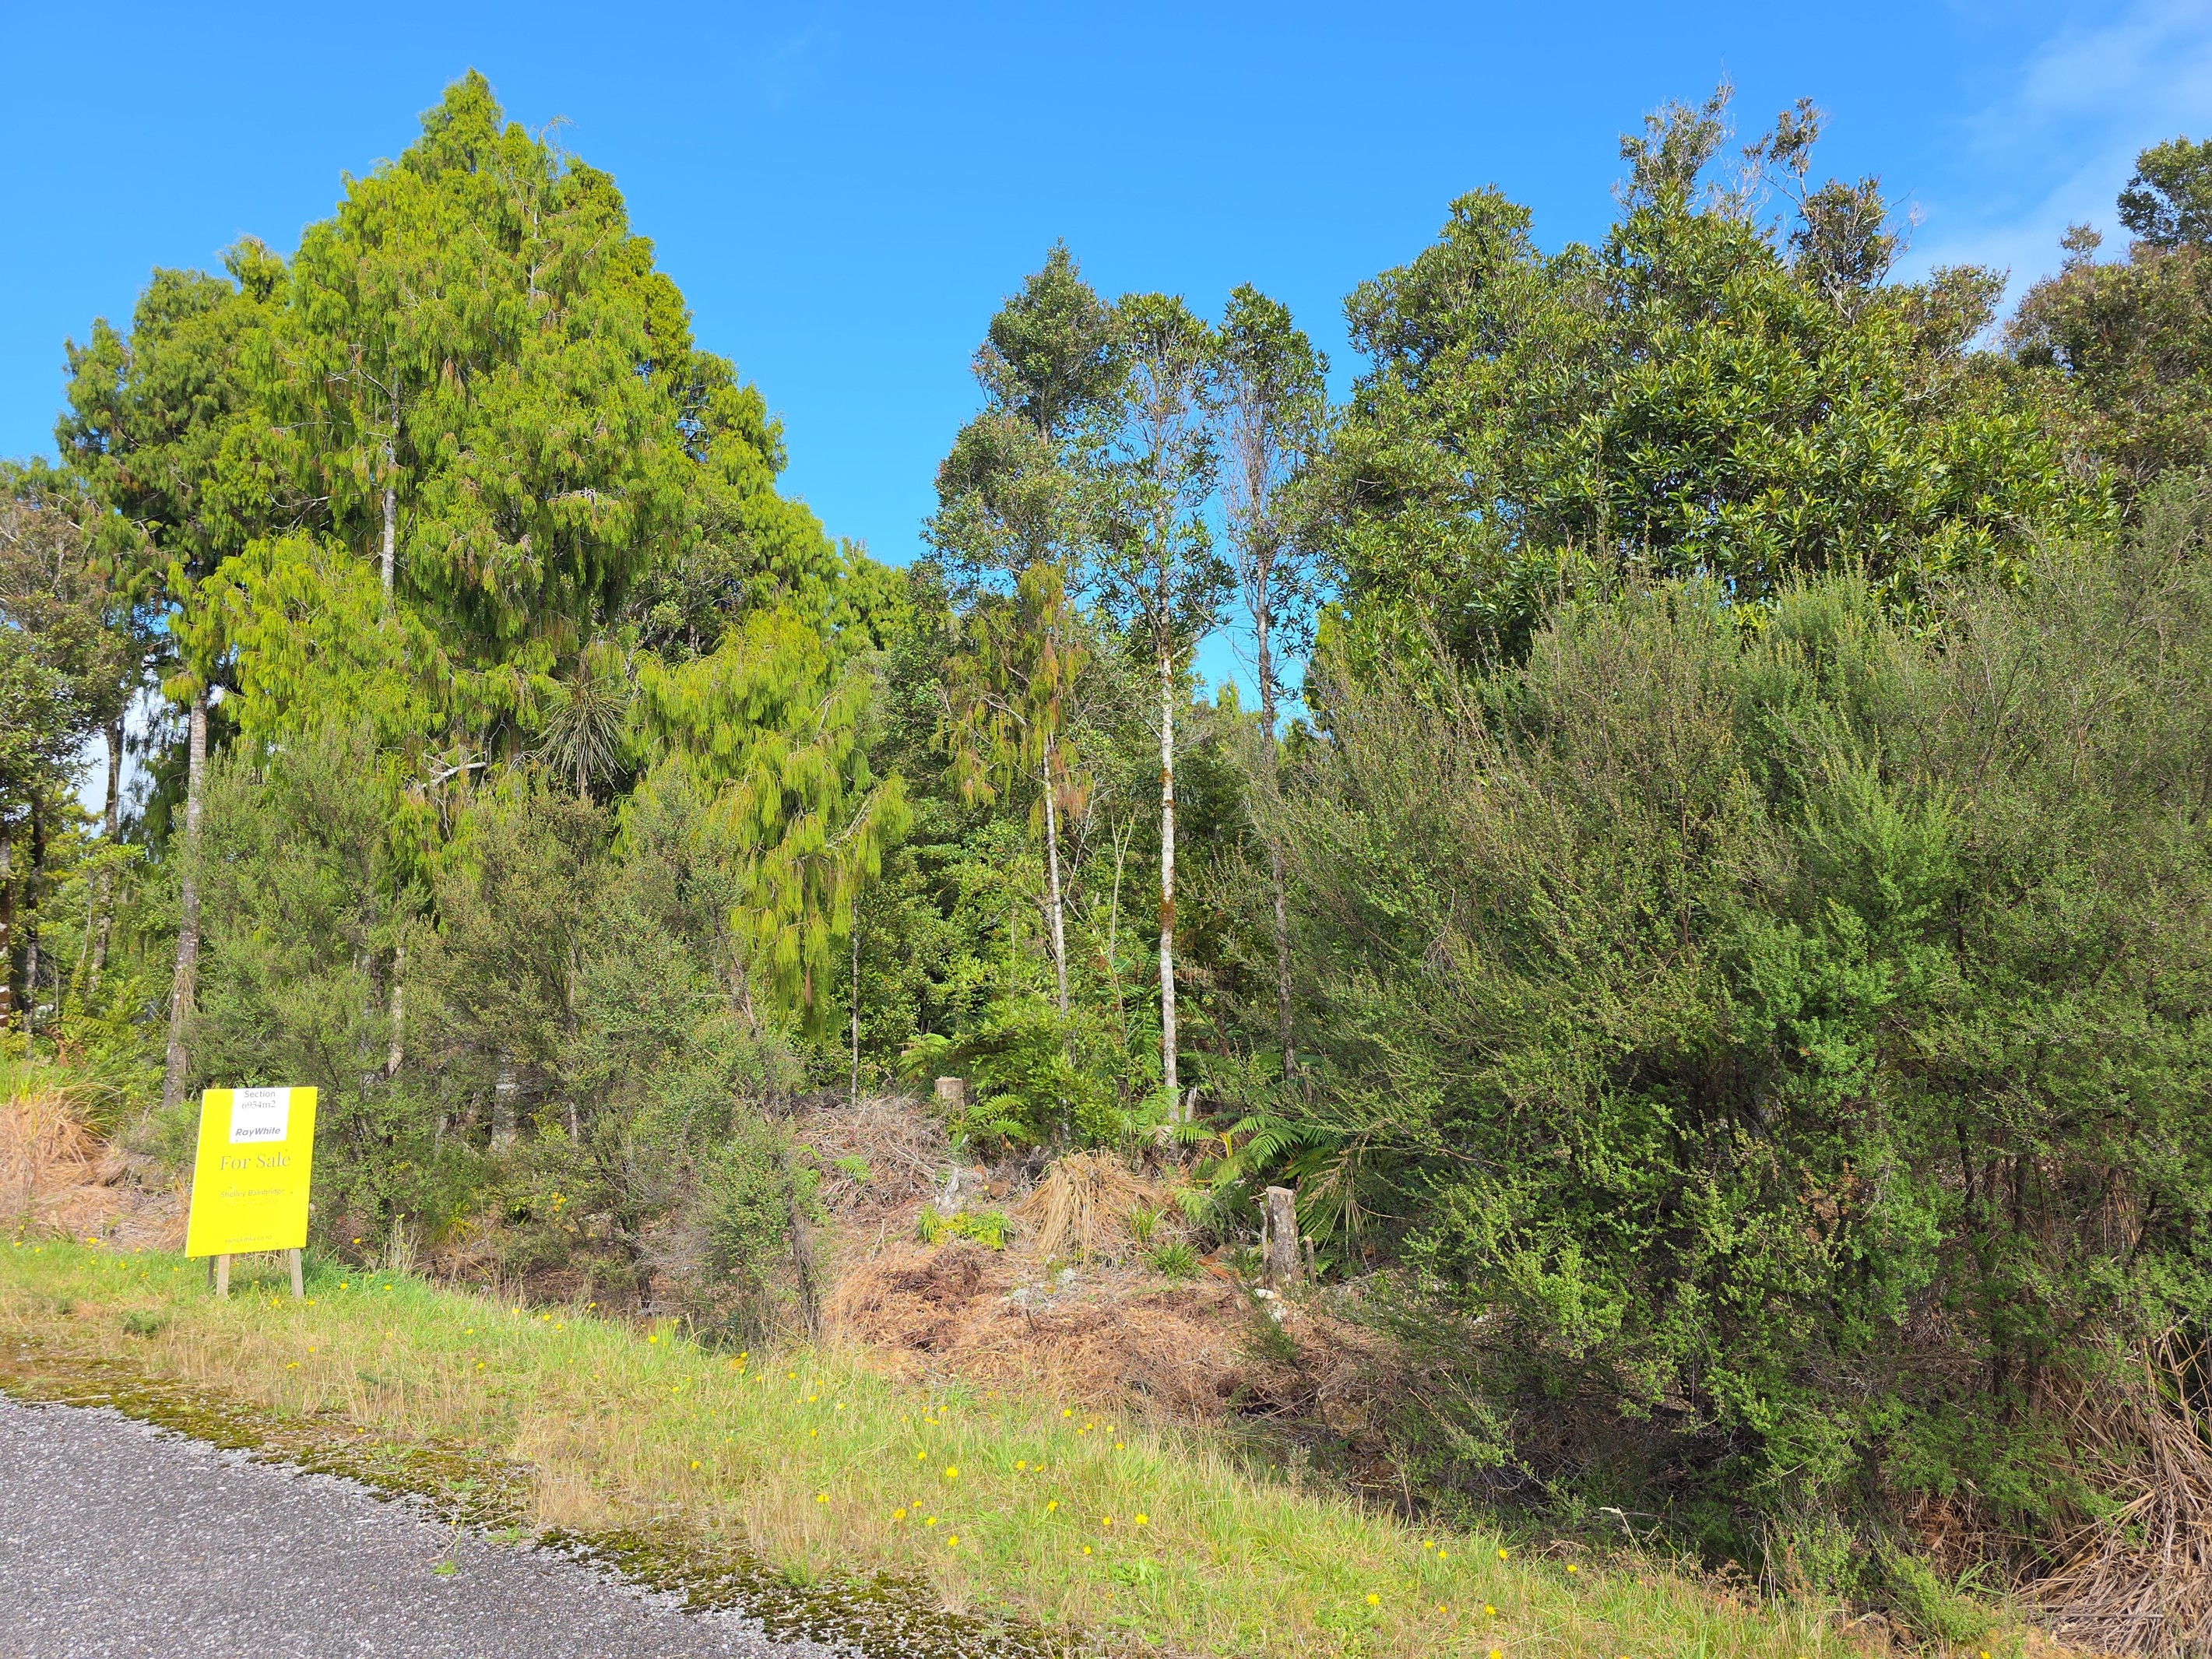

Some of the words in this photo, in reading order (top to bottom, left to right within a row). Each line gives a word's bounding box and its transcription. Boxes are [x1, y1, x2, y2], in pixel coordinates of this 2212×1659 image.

[244, 1090, 276, 1098] Section
[241, 1100, 276, 1109] 6954m2
[235, 1127, 281, 1137] RayWhite
[220, 1155, 251, 1171] For
[255, 1151, 291, 1169] Sale
[248, 1187, 285, 1197] Bainbridge
